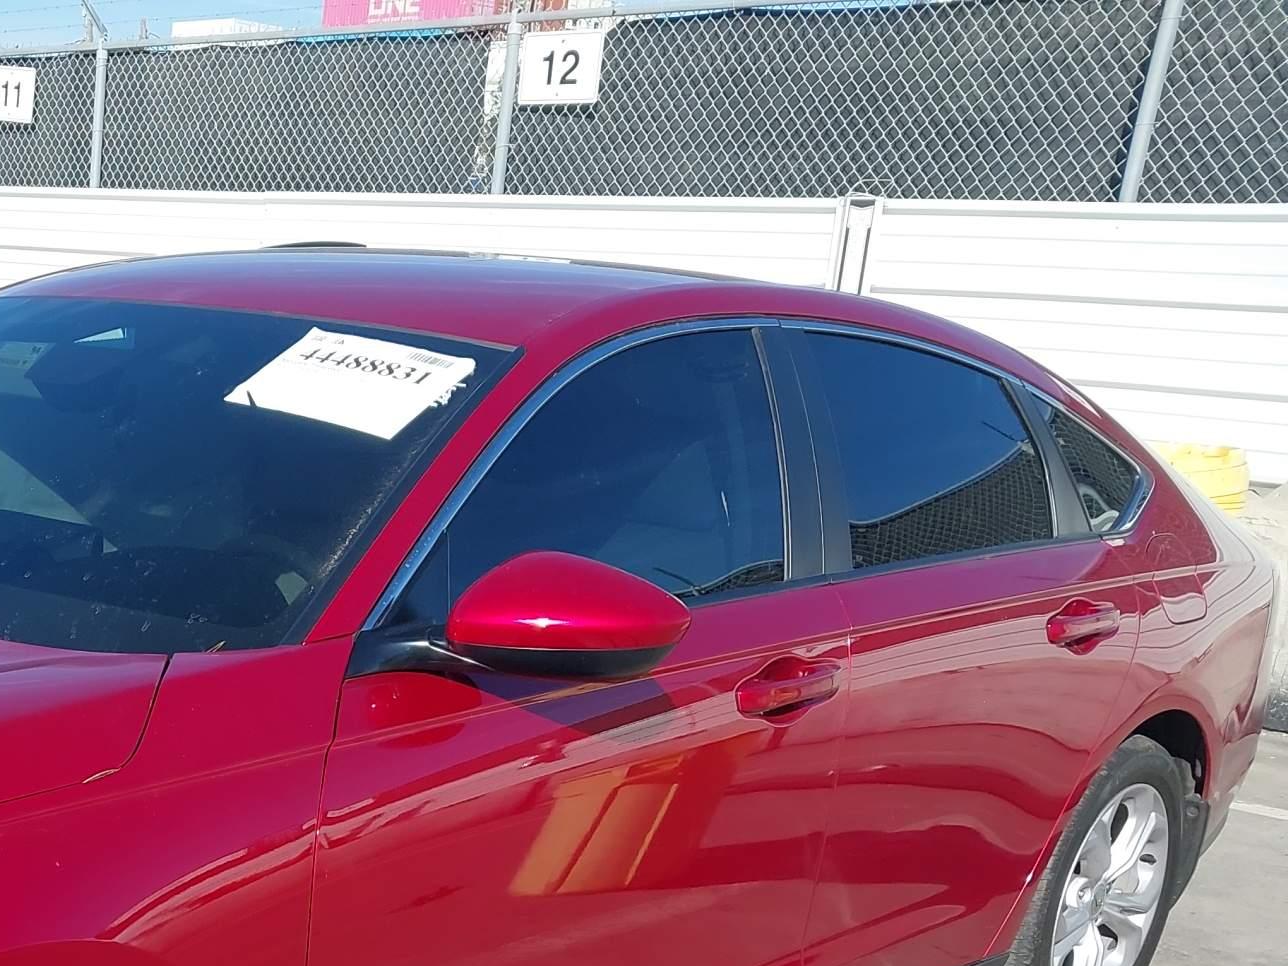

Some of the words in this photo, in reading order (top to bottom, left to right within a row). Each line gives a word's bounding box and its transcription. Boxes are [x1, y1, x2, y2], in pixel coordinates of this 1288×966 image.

[541, 49, 580, 85] 12
[1, 80, 21, 108] 11
[300, 348, 432, 384] 44488831
